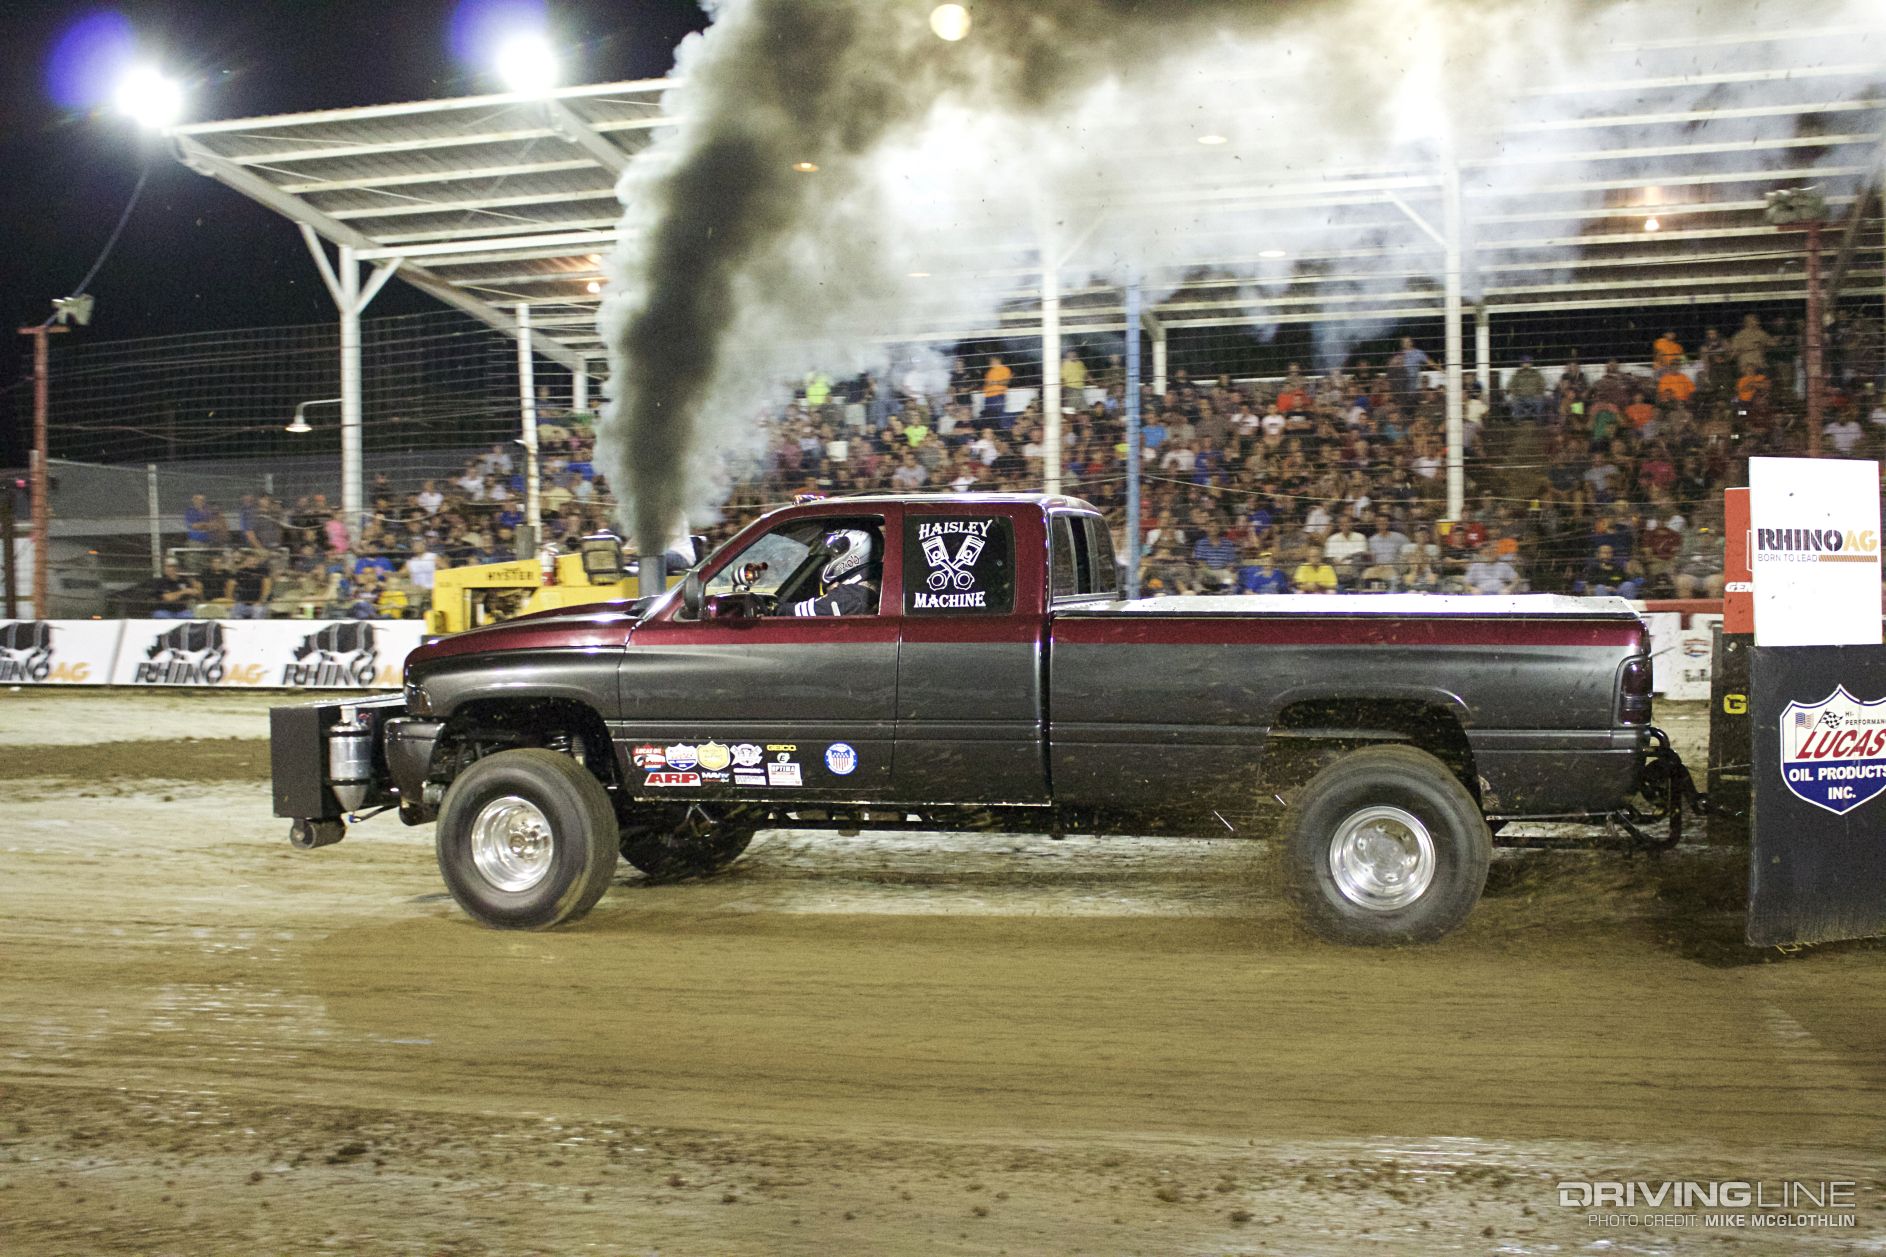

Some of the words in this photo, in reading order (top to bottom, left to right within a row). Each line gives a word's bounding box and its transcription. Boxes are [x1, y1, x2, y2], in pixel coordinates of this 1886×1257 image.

[918, 519, 993, 540] HAISLEY
[1757, 553, 1782, 562] BORN
[1784, 554, 1795, 562] TO
[1797, 554, 1818, 562] LEAD
[487, 570, 534, 581] HYSTER
[1725, 581, 1754, 593] GEN
[913, 591, 987, 608] MACHINE
[282, 663, 404, 685] RHINOA
[1723, 694, 1748, 715] G
[766, 744, 797, 752] GEICO
[1795, 728, 1886, 759] LUCAS
[647, 773, 698, 784] ARP
[1788, 768, 1814, 782] OIL
[1827, 786, 1857, 800] INC.
